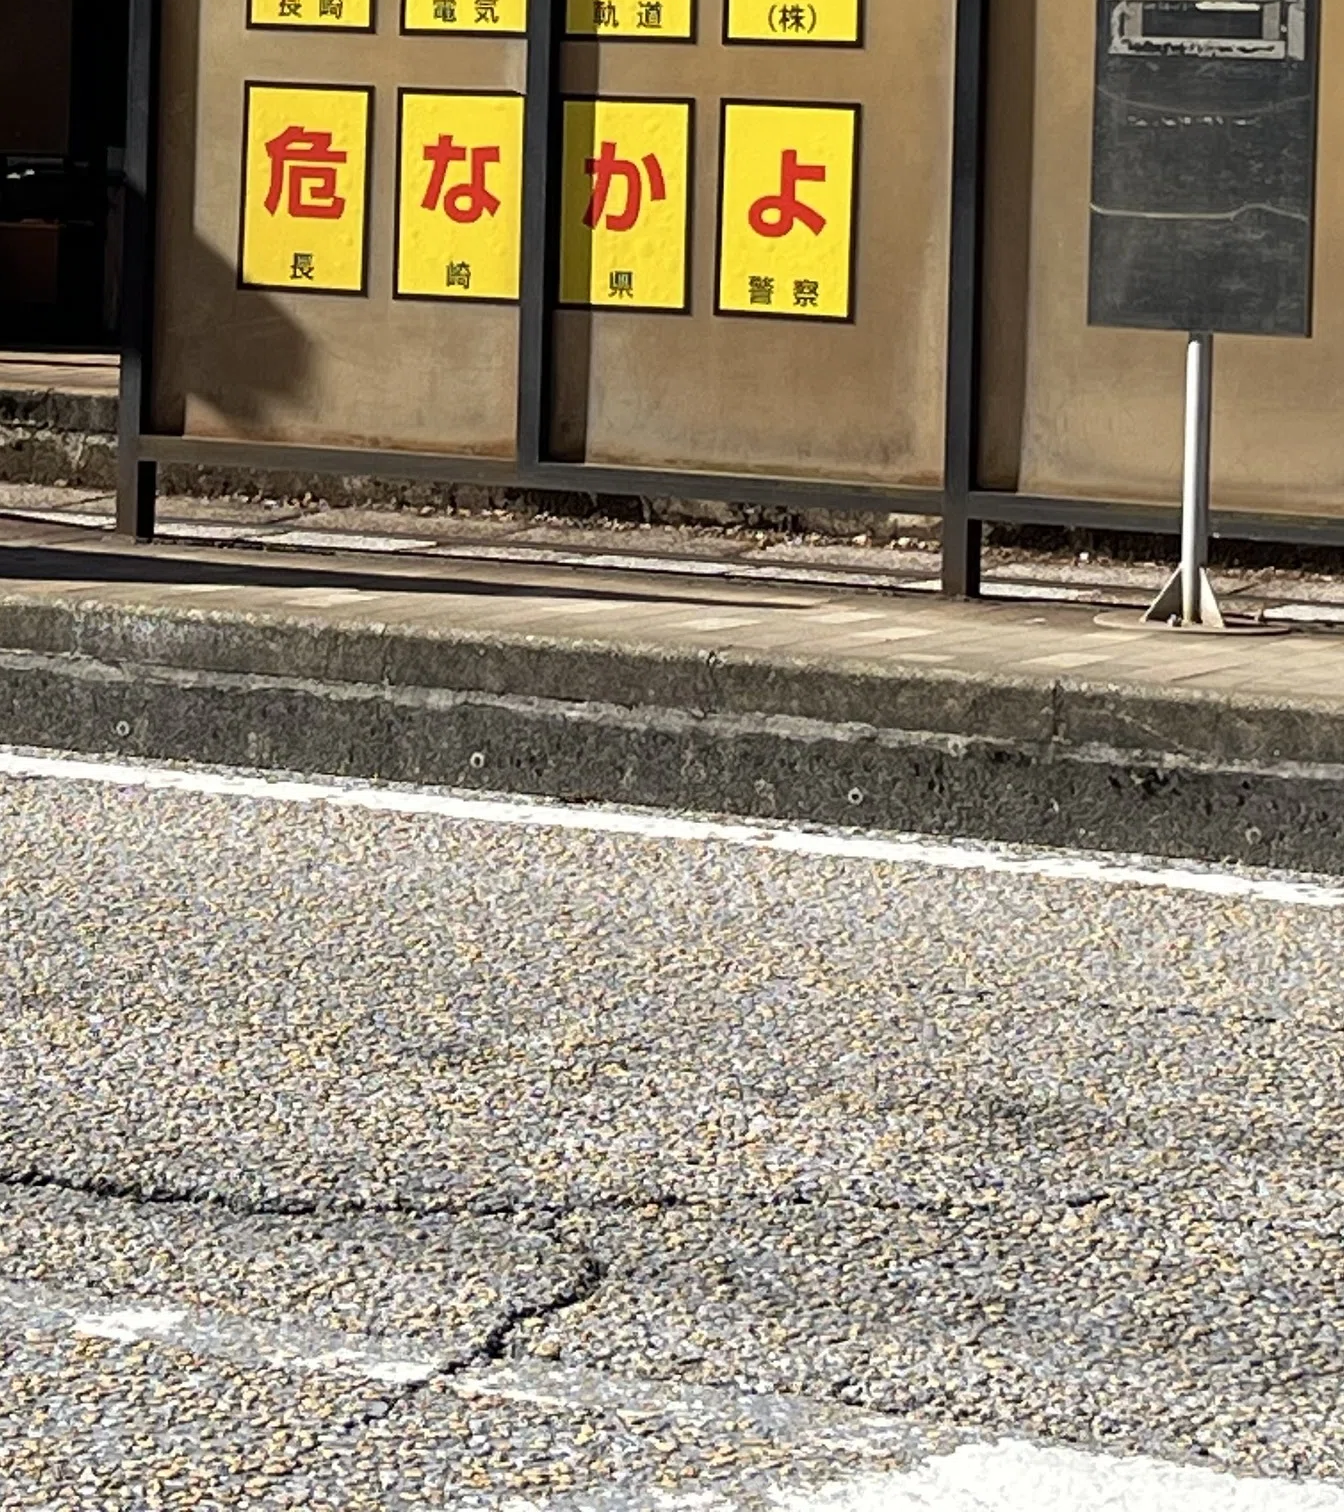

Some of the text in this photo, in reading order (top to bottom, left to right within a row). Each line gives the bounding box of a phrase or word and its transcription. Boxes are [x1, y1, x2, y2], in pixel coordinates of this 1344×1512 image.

[592, 0, 663, 29] 軌道
[768, 3, 818, 33] (株)
[748, 276, 819, 307] 警察
